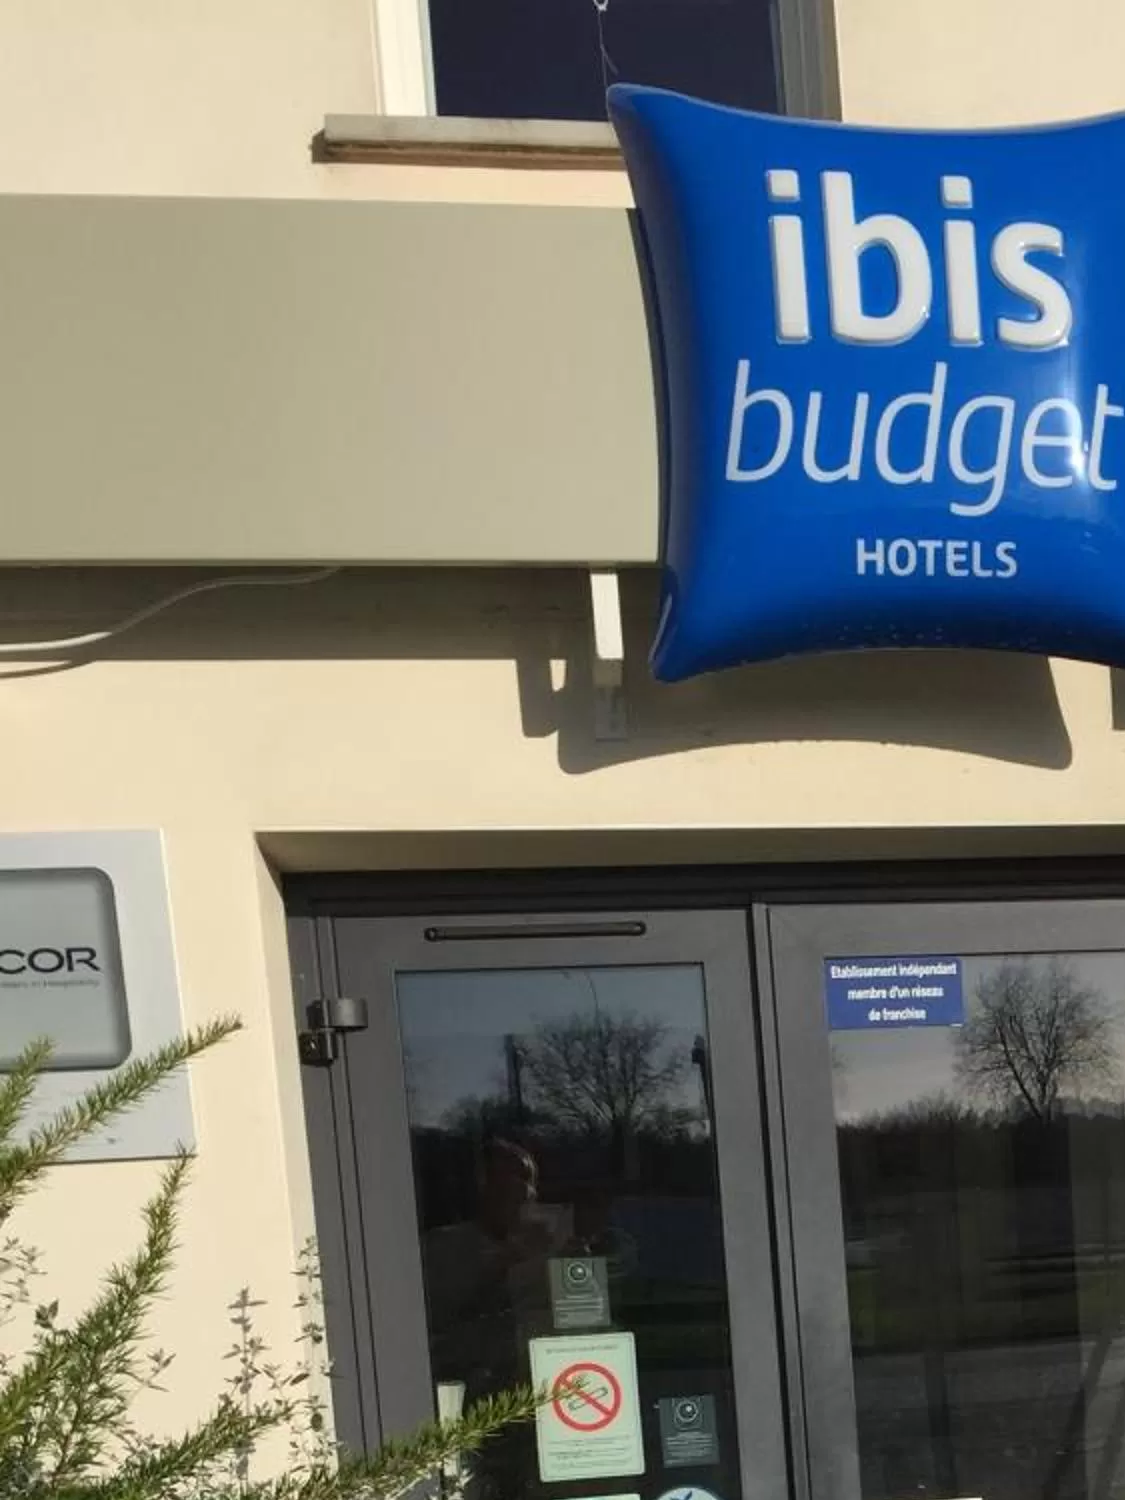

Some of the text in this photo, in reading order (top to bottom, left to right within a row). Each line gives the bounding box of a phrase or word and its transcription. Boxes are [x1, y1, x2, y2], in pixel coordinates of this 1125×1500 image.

[766, 169, 1073, 351] ibis
[725, 359, 1124, 516] budget
[856, 539, 1018, 577] HOTELS
[0, 947, 101, 974] COR
[847, 986, 887, 1000] membre
[889, 985, 911, 999] d'un
[868, 1007, 927, 1021] de franchise
